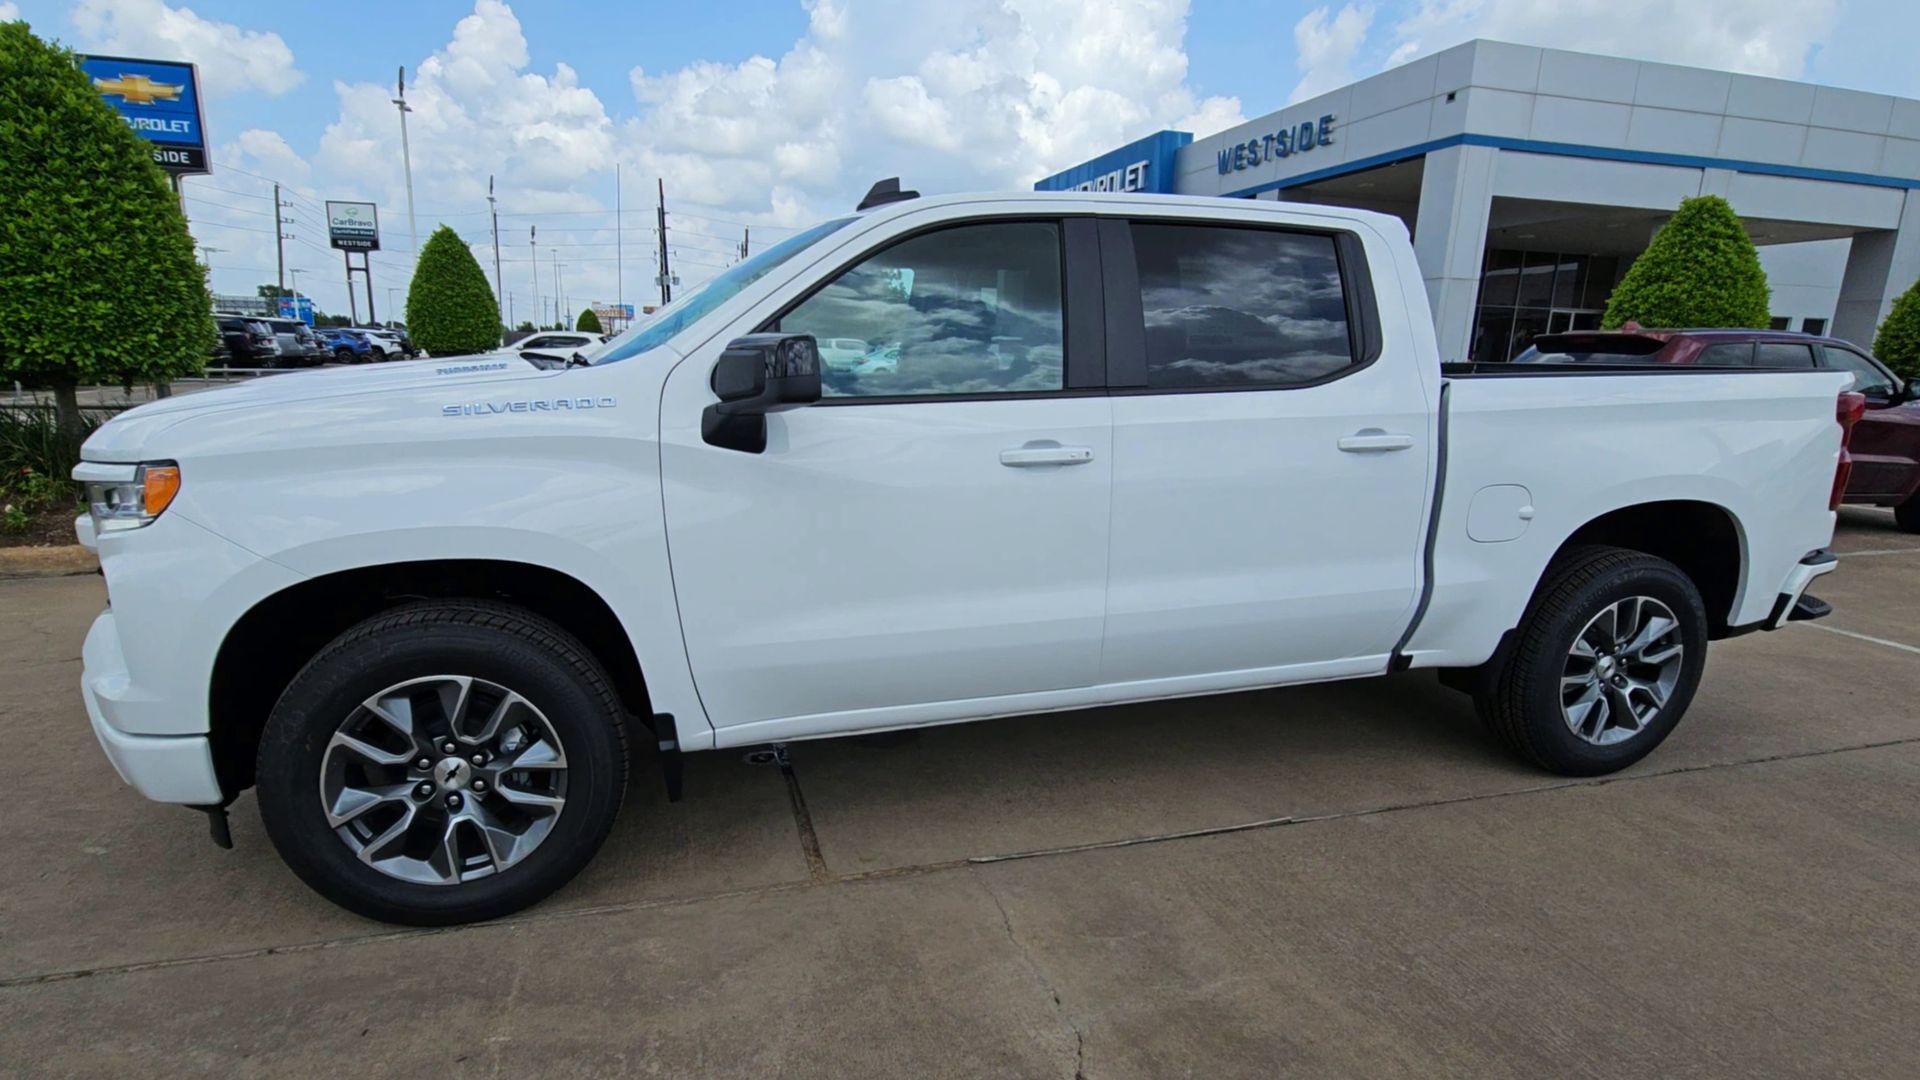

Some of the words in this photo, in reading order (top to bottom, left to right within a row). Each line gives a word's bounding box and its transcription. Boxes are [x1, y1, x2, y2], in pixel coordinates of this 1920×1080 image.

[120, 116, 190, 133] VROLET
[1217, 113, 1336, 176] WESTSIDE
[153, 150, 190, 164] SIDE
[332, 217, 373, 227] CarBravo
[442, 396, 617, 417] SILVERADO
